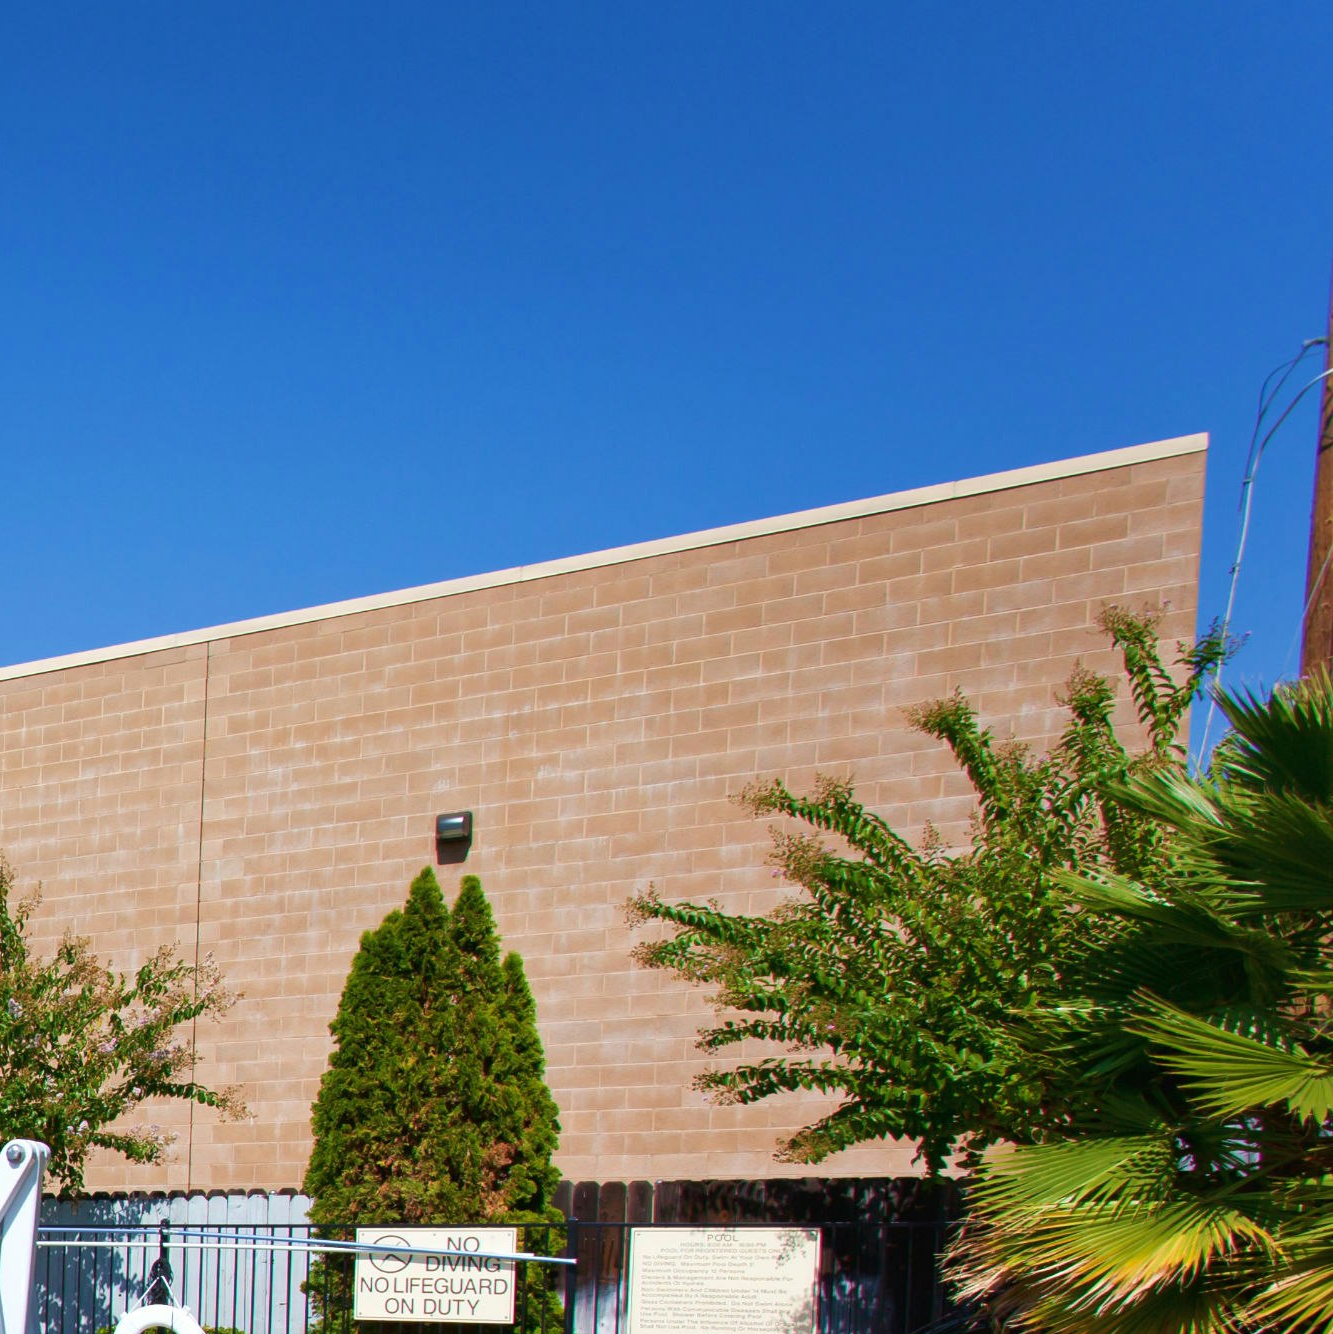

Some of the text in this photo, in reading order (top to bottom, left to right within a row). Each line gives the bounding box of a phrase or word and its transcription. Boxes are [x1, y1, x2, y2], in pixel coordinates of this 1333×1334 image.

[447, 1236, 480, 1252] NO
[706, 1234, 740, 1242] POOL
[426, 1255, 501, 1272] DIVING
[360, 1277, 508, 1295] NO LIFEGUARD
[385, 1298, 480, 1316] ON DUTY
